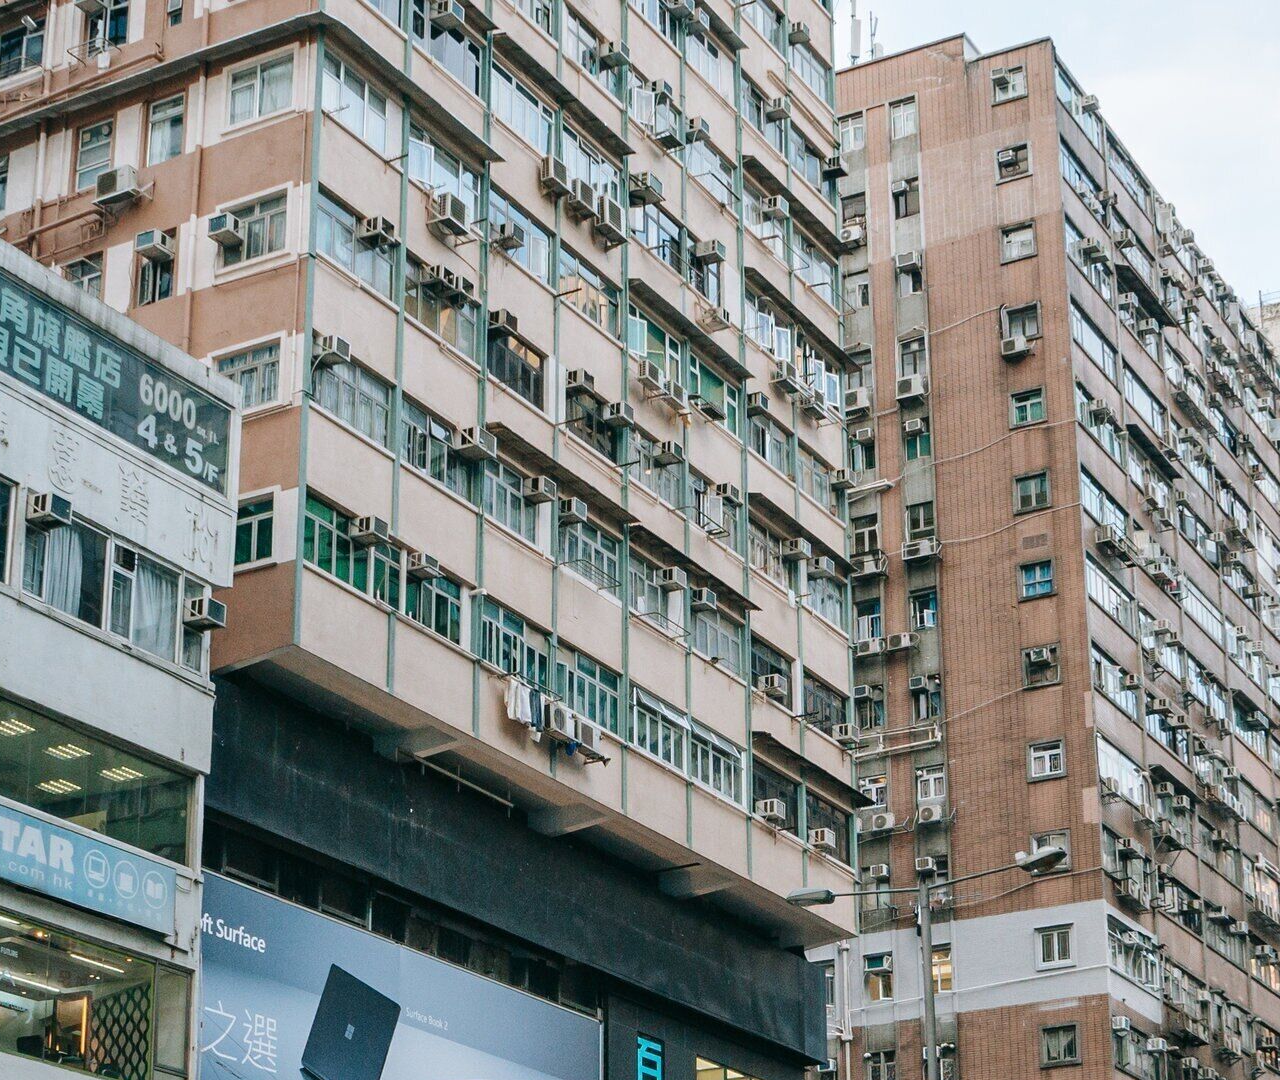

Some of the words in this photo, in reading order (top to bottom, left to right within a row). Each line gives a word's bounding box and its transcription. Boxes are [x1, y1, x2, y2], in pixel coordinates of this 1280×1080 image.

[139, 373, 197, 430] 6000
[137, 414, 158, 449] 4
[163, 433, 178, 456] &
[184, 438, 220, 484] 5/F
[215, 920, 267, 954] Surface
[200, 1000, 279, 1074] 之選
